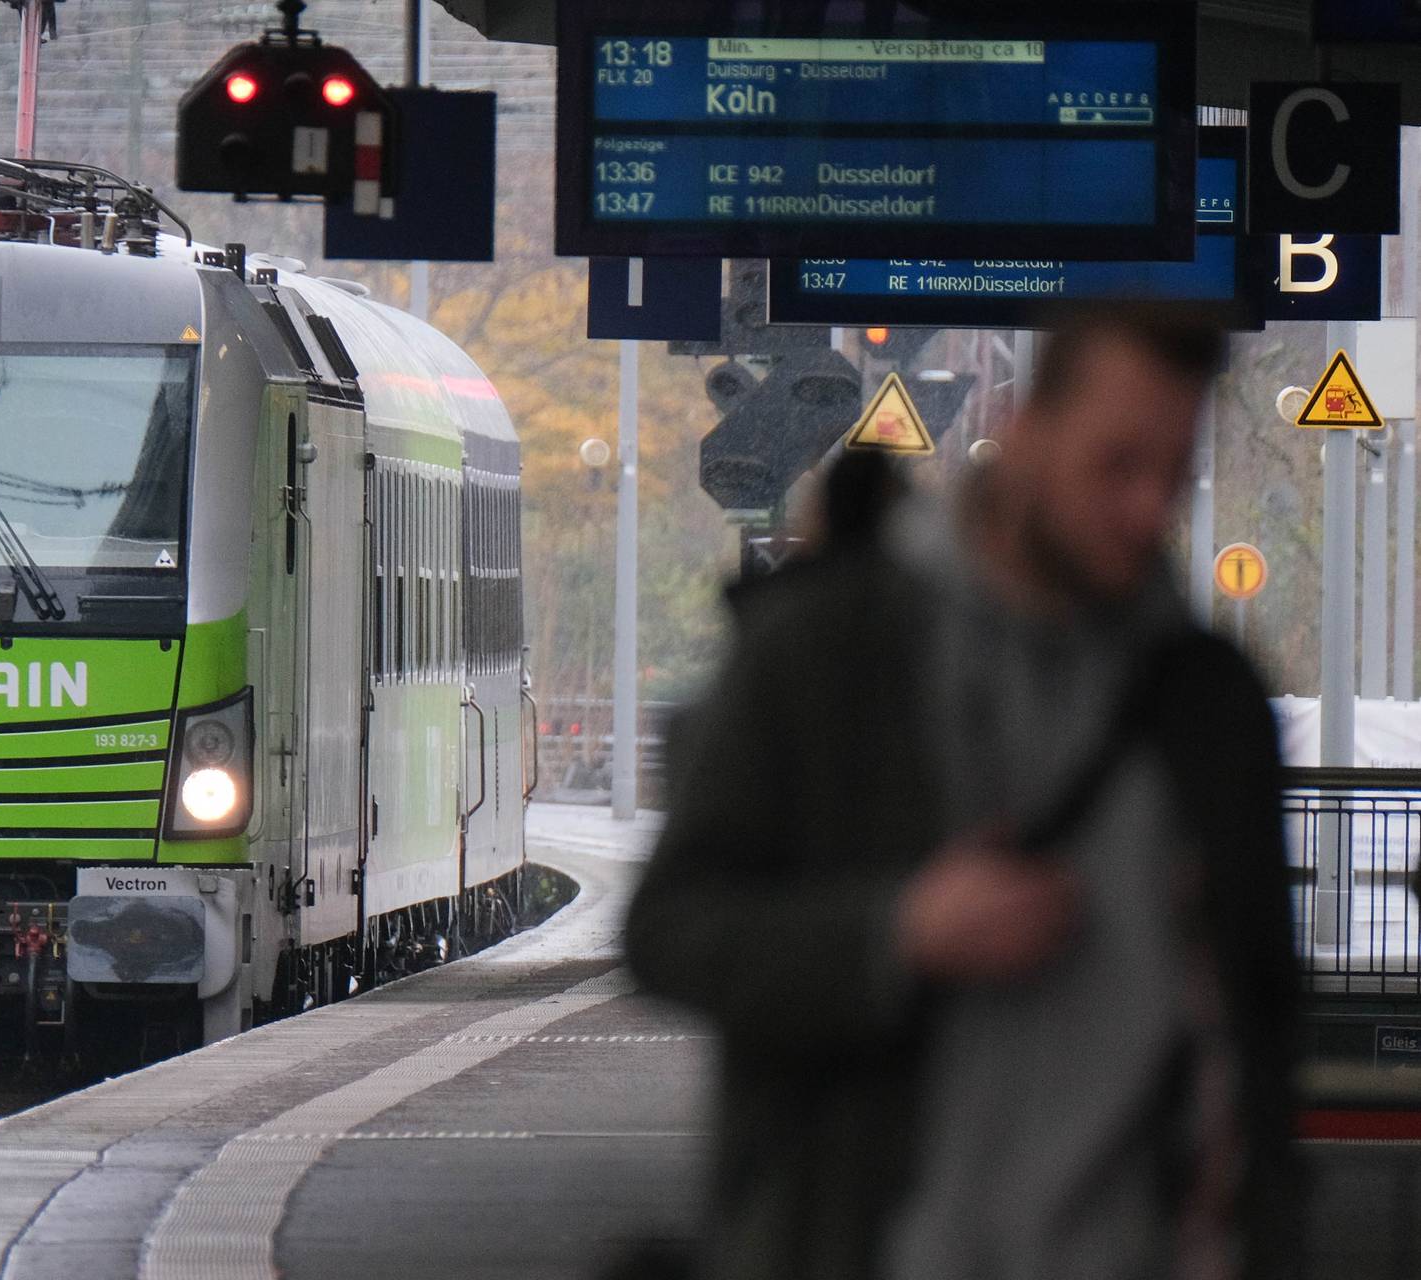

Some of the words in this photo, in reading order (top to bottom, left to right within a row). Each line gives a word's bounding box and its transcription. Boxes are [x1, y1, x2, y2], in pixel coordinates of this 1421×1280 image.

[601, 40, 673, 66] 13:18
[871, 40, 984, 60] Verspätung
[992, 43, 1015, 57] ca
[1024, 41, 1044, 58] 10
[598, 68, 627, 84] FLX
[633, 68, 653, 84] 20
[707, 62, 776, 80] Duisburg
[800, 62, 888, 80] Düsseldorf
[706, 83, 776, 114] Köln
[1272, 87, 1351, 200] C
[596, 161, 656, 183] 13:36
[709, 164, 739, 183] ICE
[747, 165, 784, 184] 942
[817, 162, 936, 185] Düsseldorf
[596, 191, 656, 214] 13:47
[709, 196, 734, 214] RE
[817, 193, 935, 216] Düsseldorf
[1200, 198, 1207, 208] E
[1212, 198, 1219, 208] F
[1223, 198, 1230, 208] G
[1279, 232, 1339, 293] B
[801, 272, 846, 289] 13:47
[889, 275, 909, 290] RE
[973, 275, 1065, 292] Düsseldorf
[95, 733, 117, 747] 193
[120, 733, 158, 747] 827-3
[105, 876, 167, 891] Vectron
[1381, 1035, 1418, 1049] Gleis
